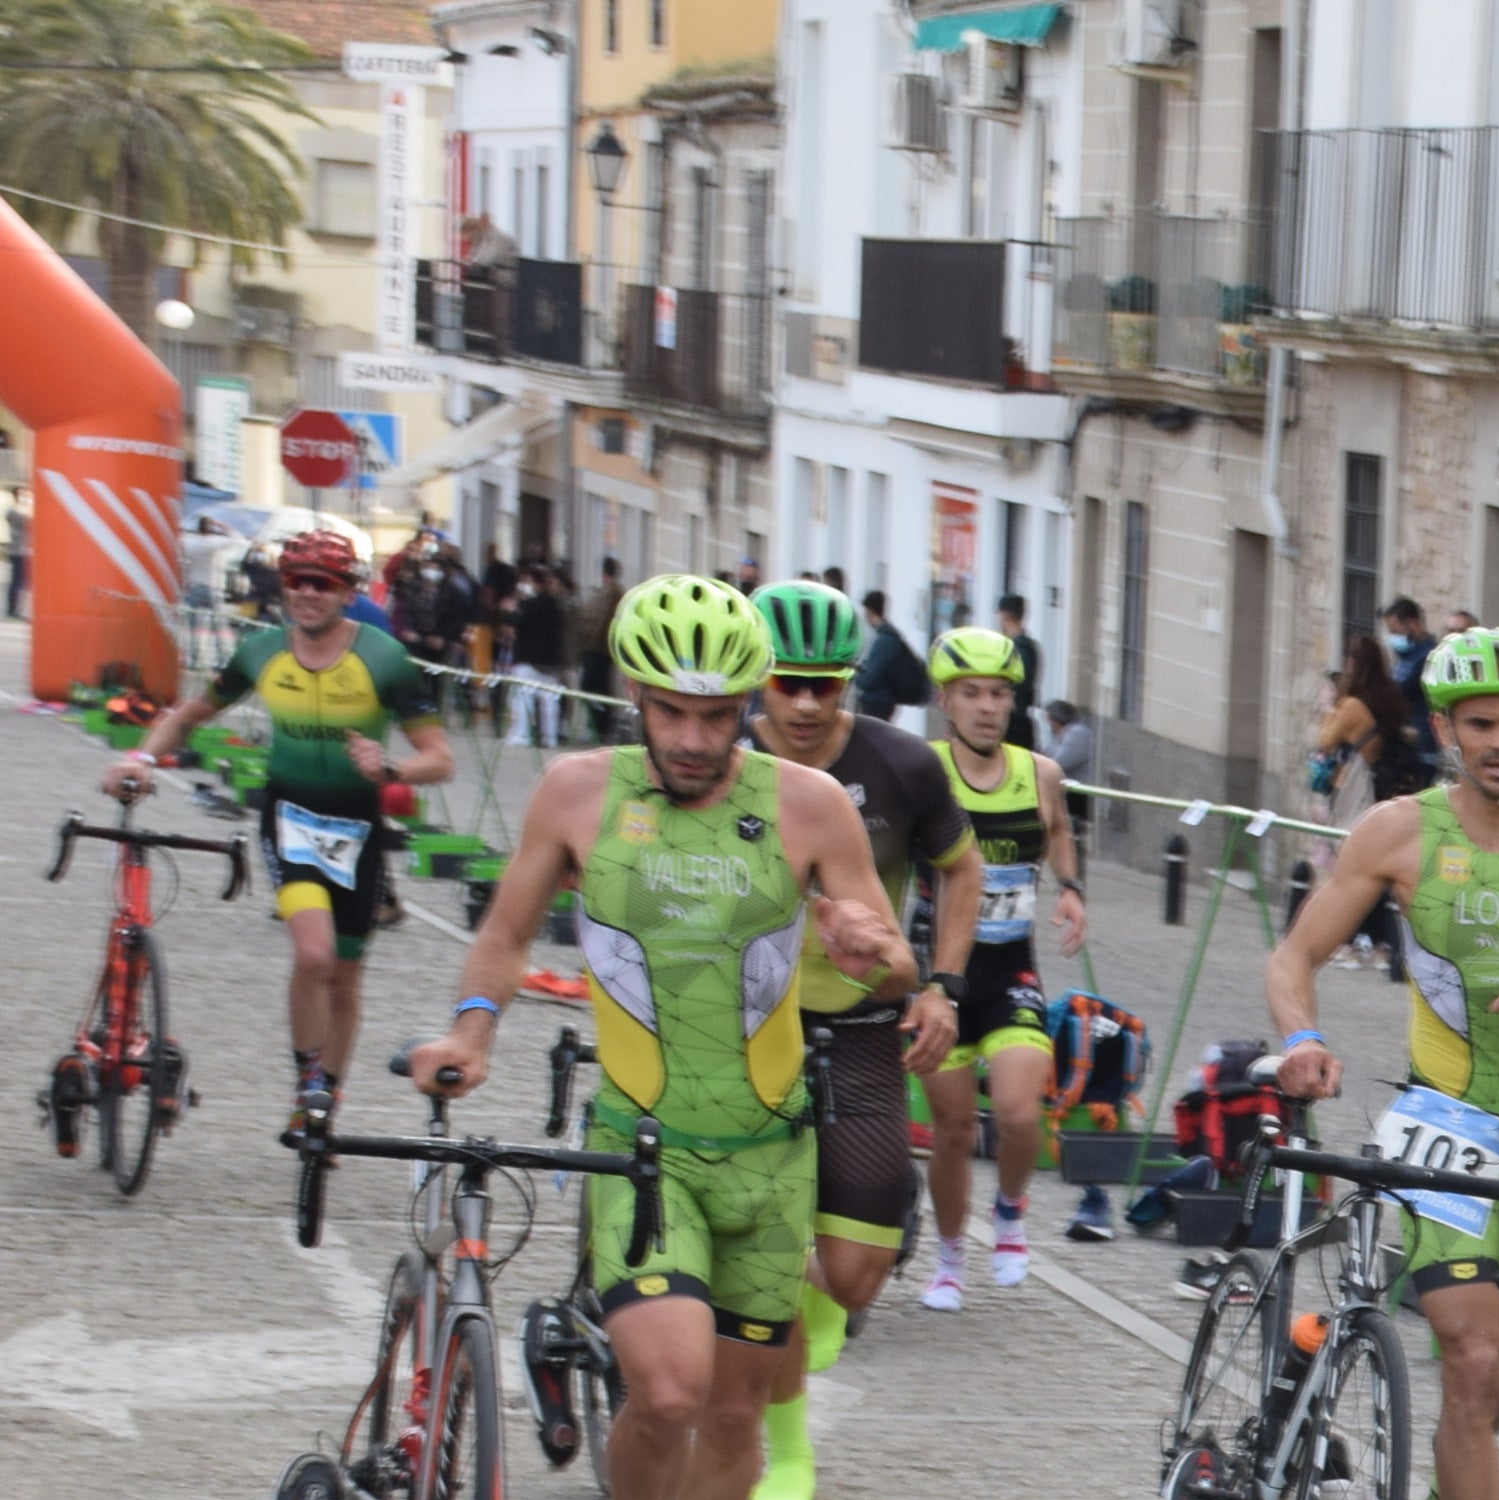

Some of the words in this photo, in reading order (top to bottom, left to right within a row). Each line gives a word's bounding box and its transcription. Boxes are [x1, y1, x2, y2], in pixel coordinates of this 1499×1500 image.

[283, 437, 355, 458] STOP
[642, 852, 751, 898] VALERIO
[1391, 1124, 1488, 1176] 103
